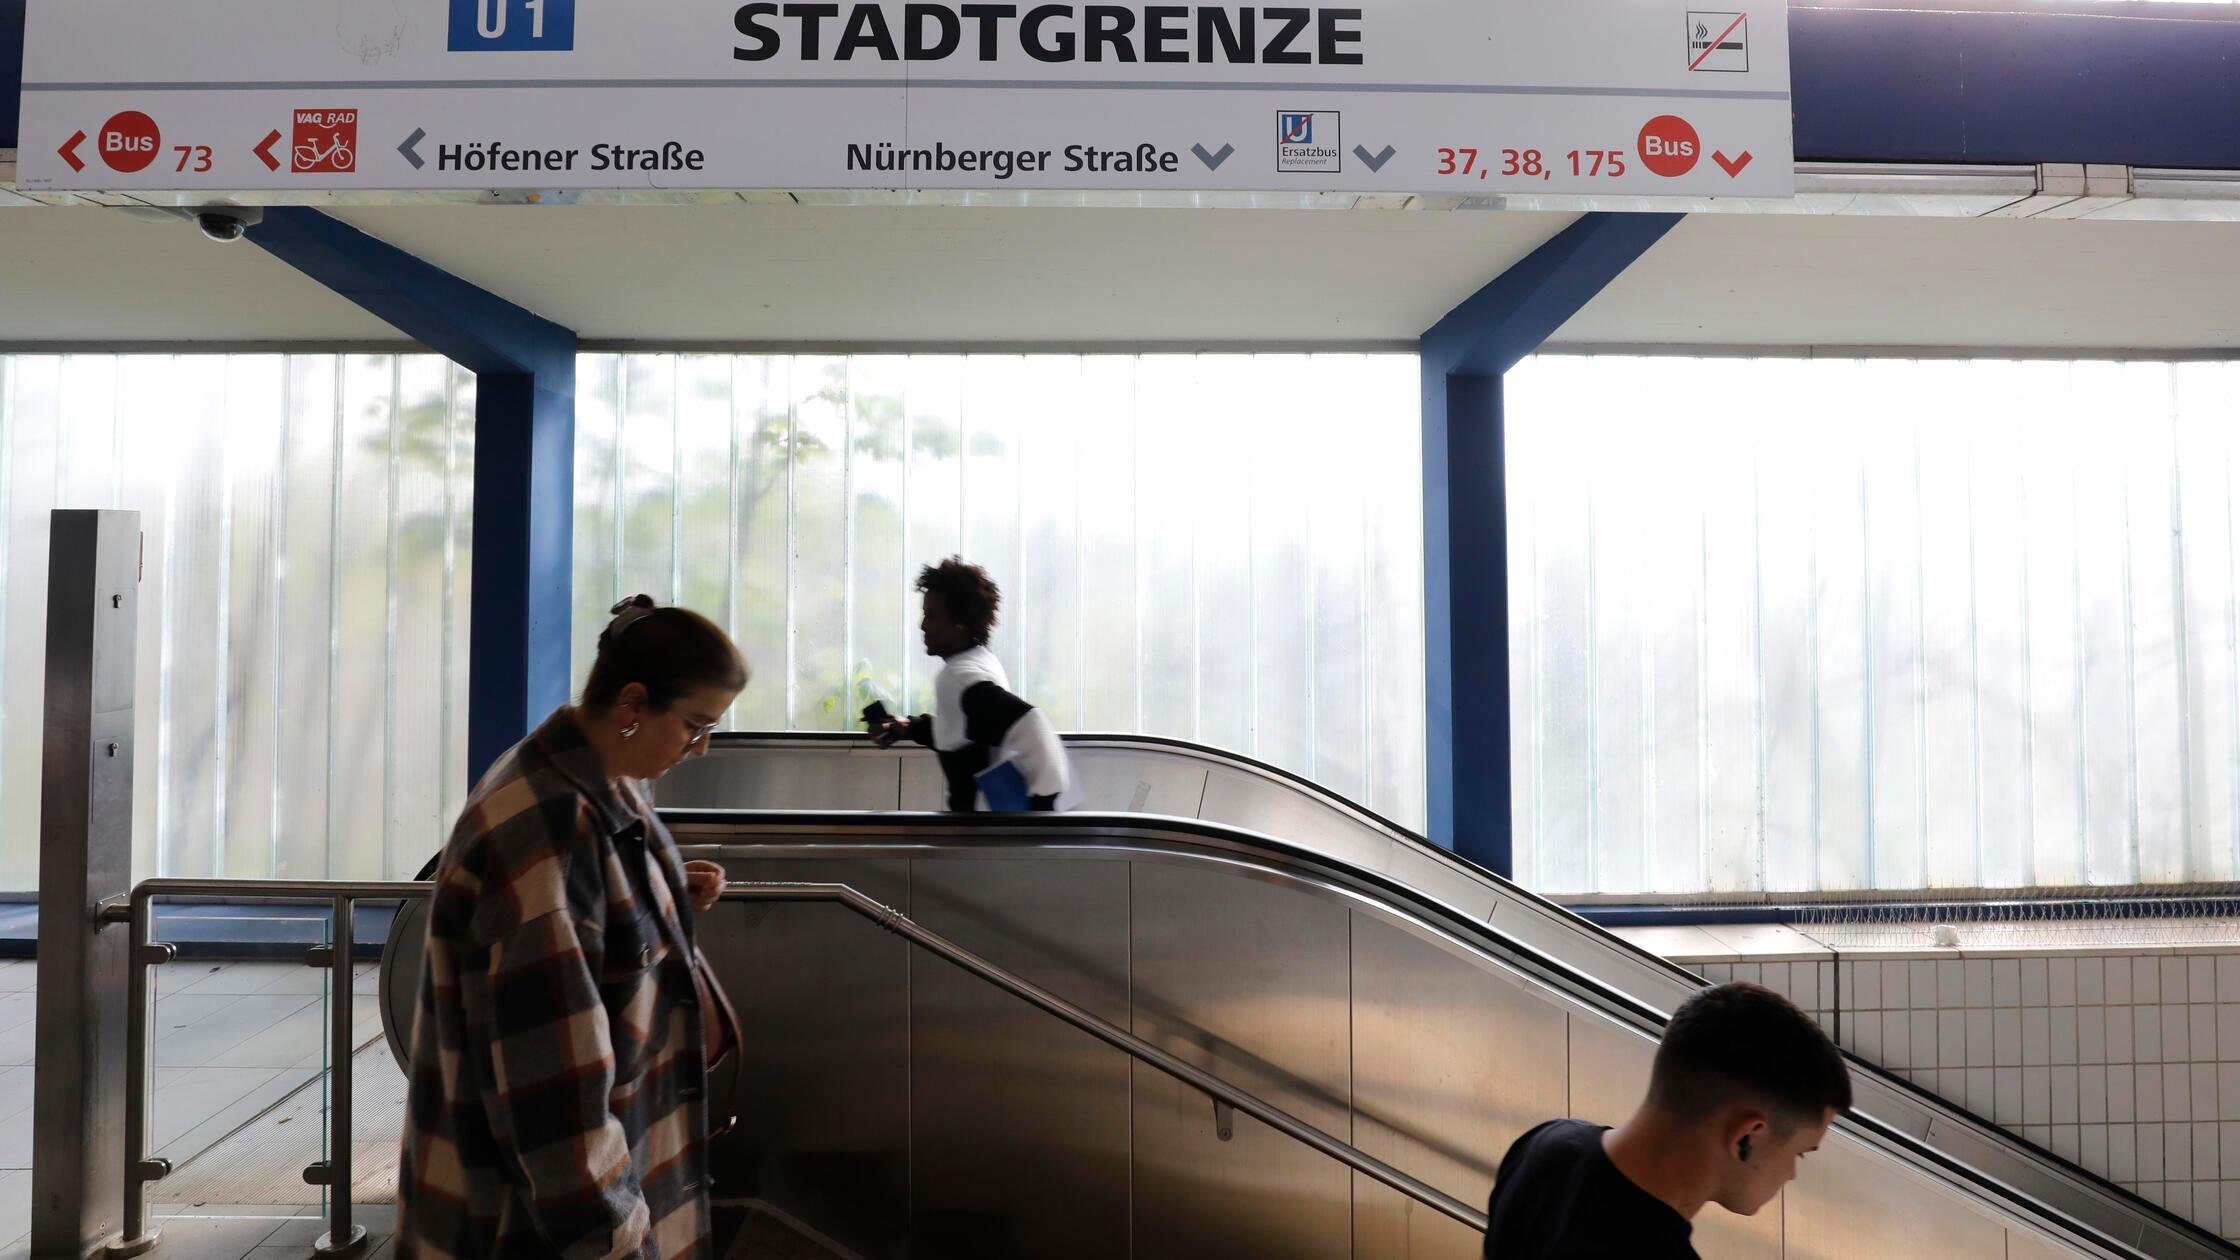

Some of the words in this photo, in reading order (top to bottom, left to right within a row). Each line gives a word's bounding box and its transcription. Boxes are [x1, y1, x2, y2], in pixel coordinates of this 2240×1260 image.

[733, 3, 1363, 65] STADTGRENZE
[296, 112, 323, 124] VAG
[326, 112, 355, 124] RAD
[1286, 115, 1308, 142] U
[106, 131, 154, 152] Bus
[174, 145, 212, 172] 73
[438, 141, 579, 171] Höfener
[590, 141, 705, 171] Straße
[847, 141, 1052, 180] Nürnberger
[1064, 143, 1179, 173] Straße
[1281, 157, 1328, 167] Replacement
[1282, 146, 1337, 157] Ersatzbus
[1438, 147, 1488, 179] 37,
[1502, 148, 1552, 180] 38,
[1566, 149, 1627, 177] 175
[1645, 135, 1694, 157] Bus
